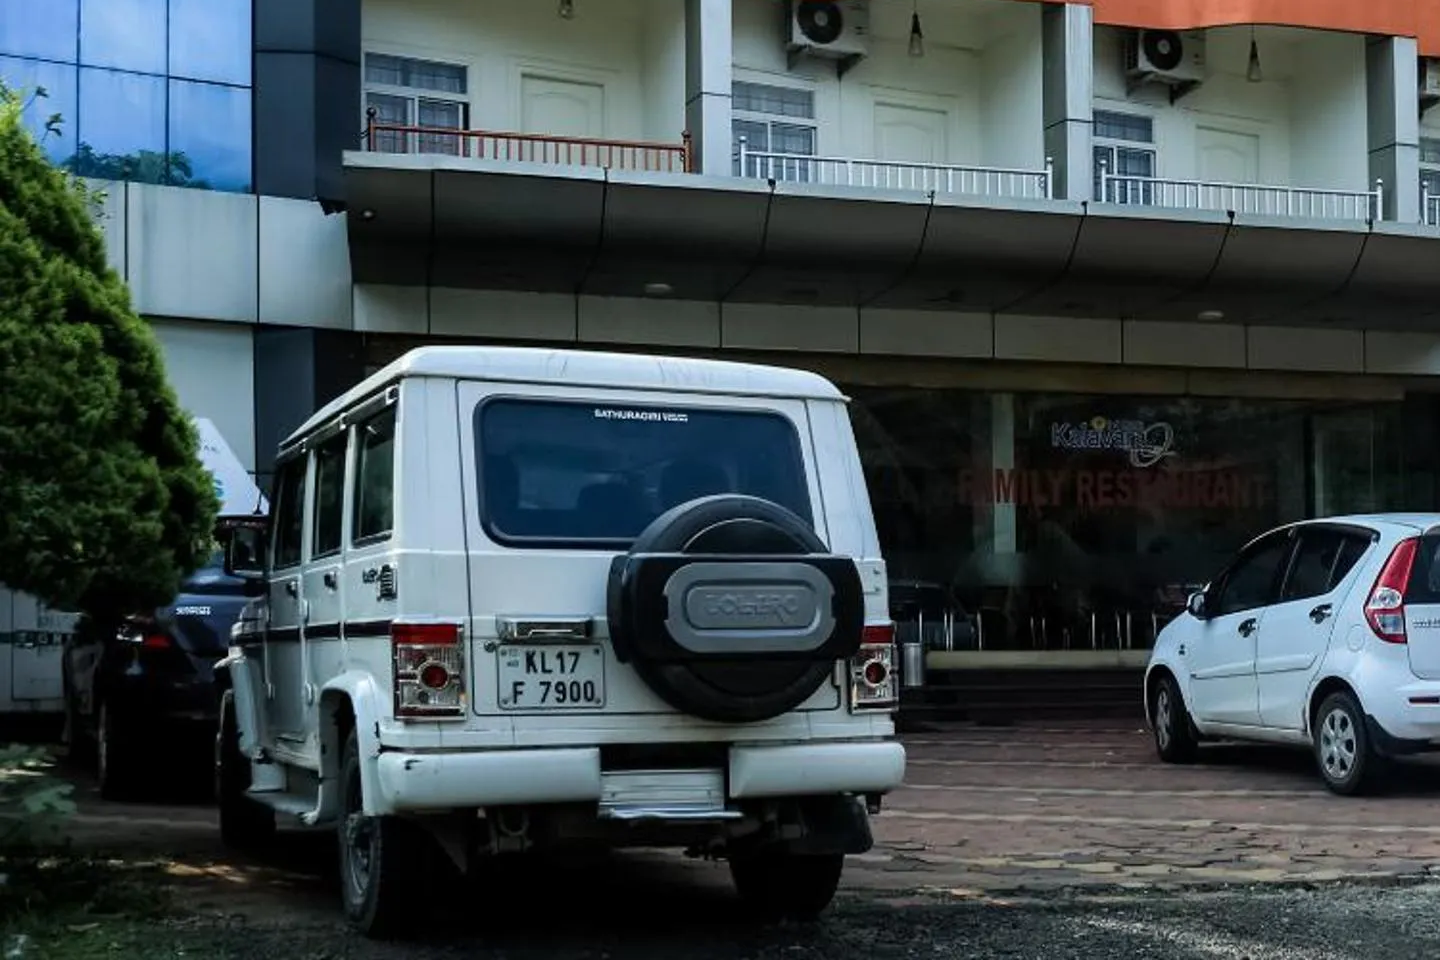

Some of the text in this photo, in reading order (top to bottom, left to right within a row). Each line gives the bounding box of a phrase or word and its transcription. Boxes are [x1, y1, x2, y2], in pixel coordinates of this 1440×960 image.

[958, 468, 1268, 510] FAMILY RESTAURANT
[525, 650, 581, 674] KL17
[513, 680, 595, 704] F 7900
